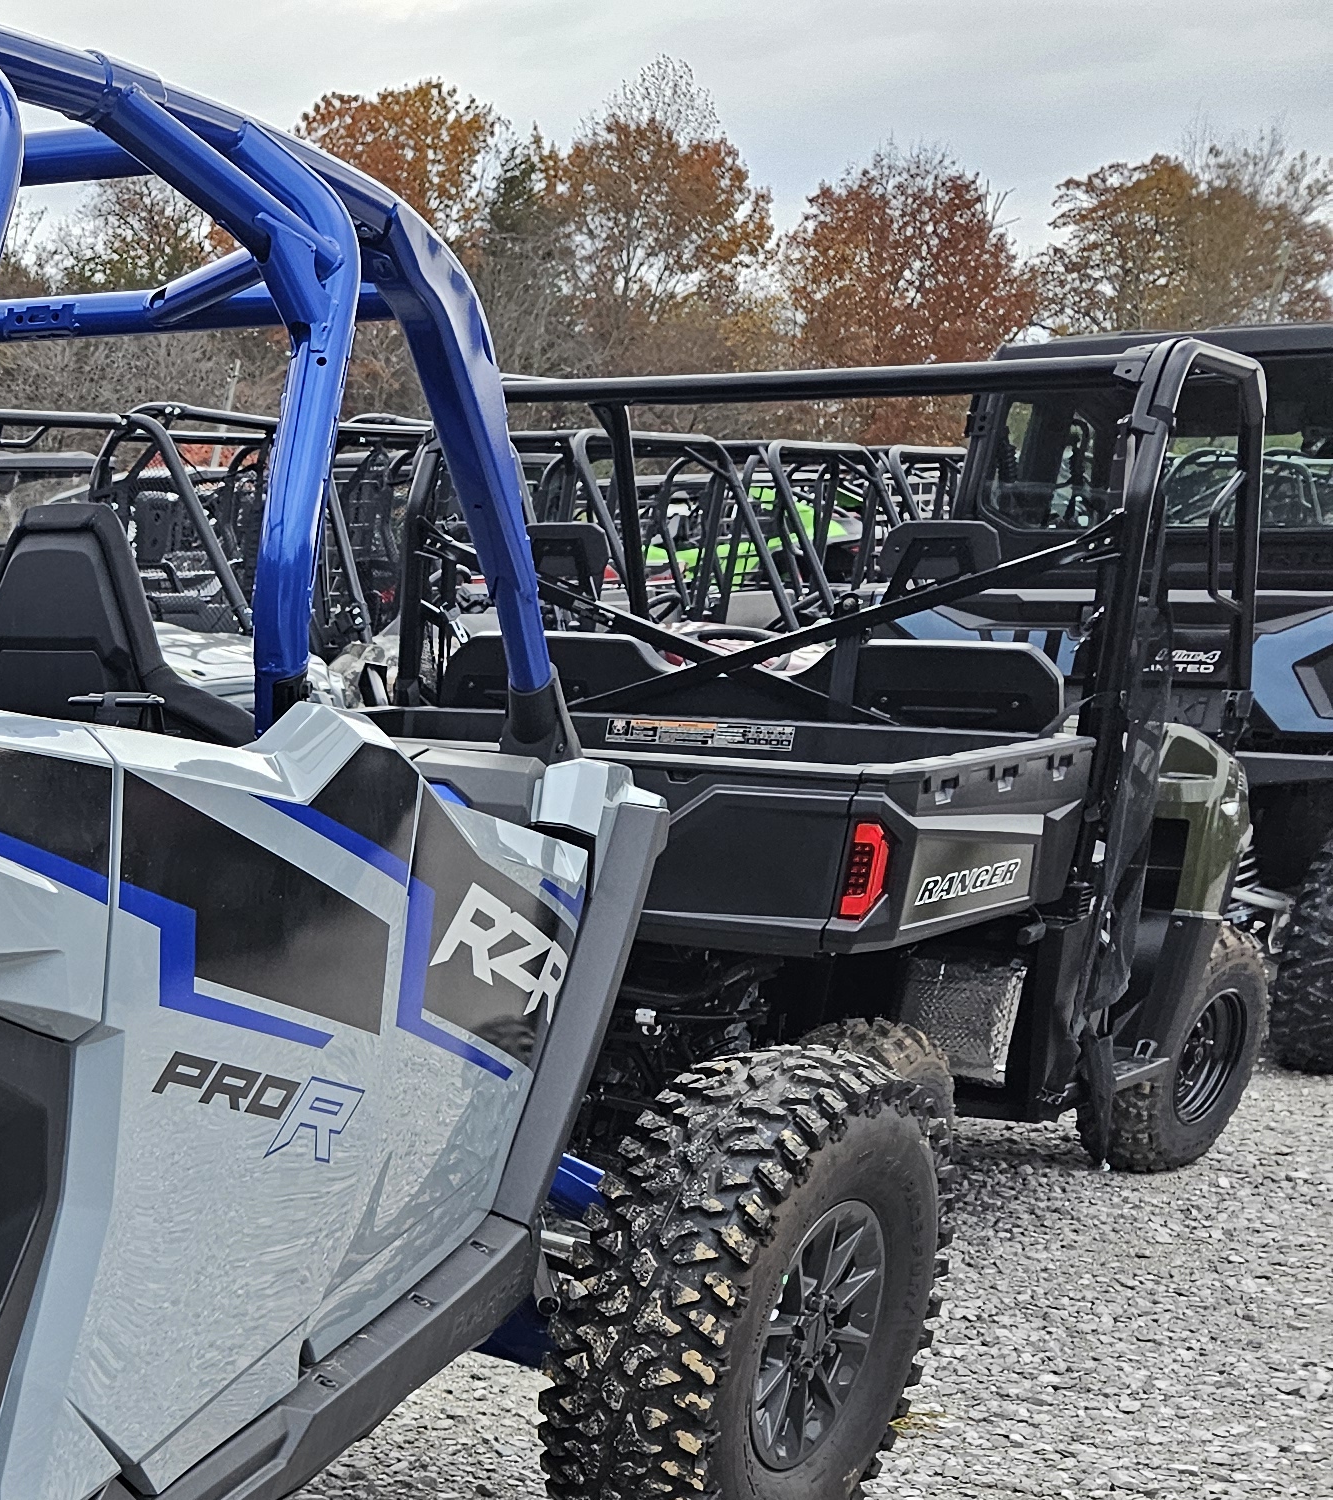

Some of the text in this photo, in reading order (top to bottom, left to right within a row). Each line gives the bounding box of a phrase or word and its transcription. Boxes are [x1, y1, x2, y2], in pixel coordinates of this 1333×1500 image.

[1142, 664, 1215, 674] LIMTED
[914, 858, 1023, 907] RANGER
[430, 881, 567, 1024] RZR
[151, 1051, 365, 1164] PRO R
